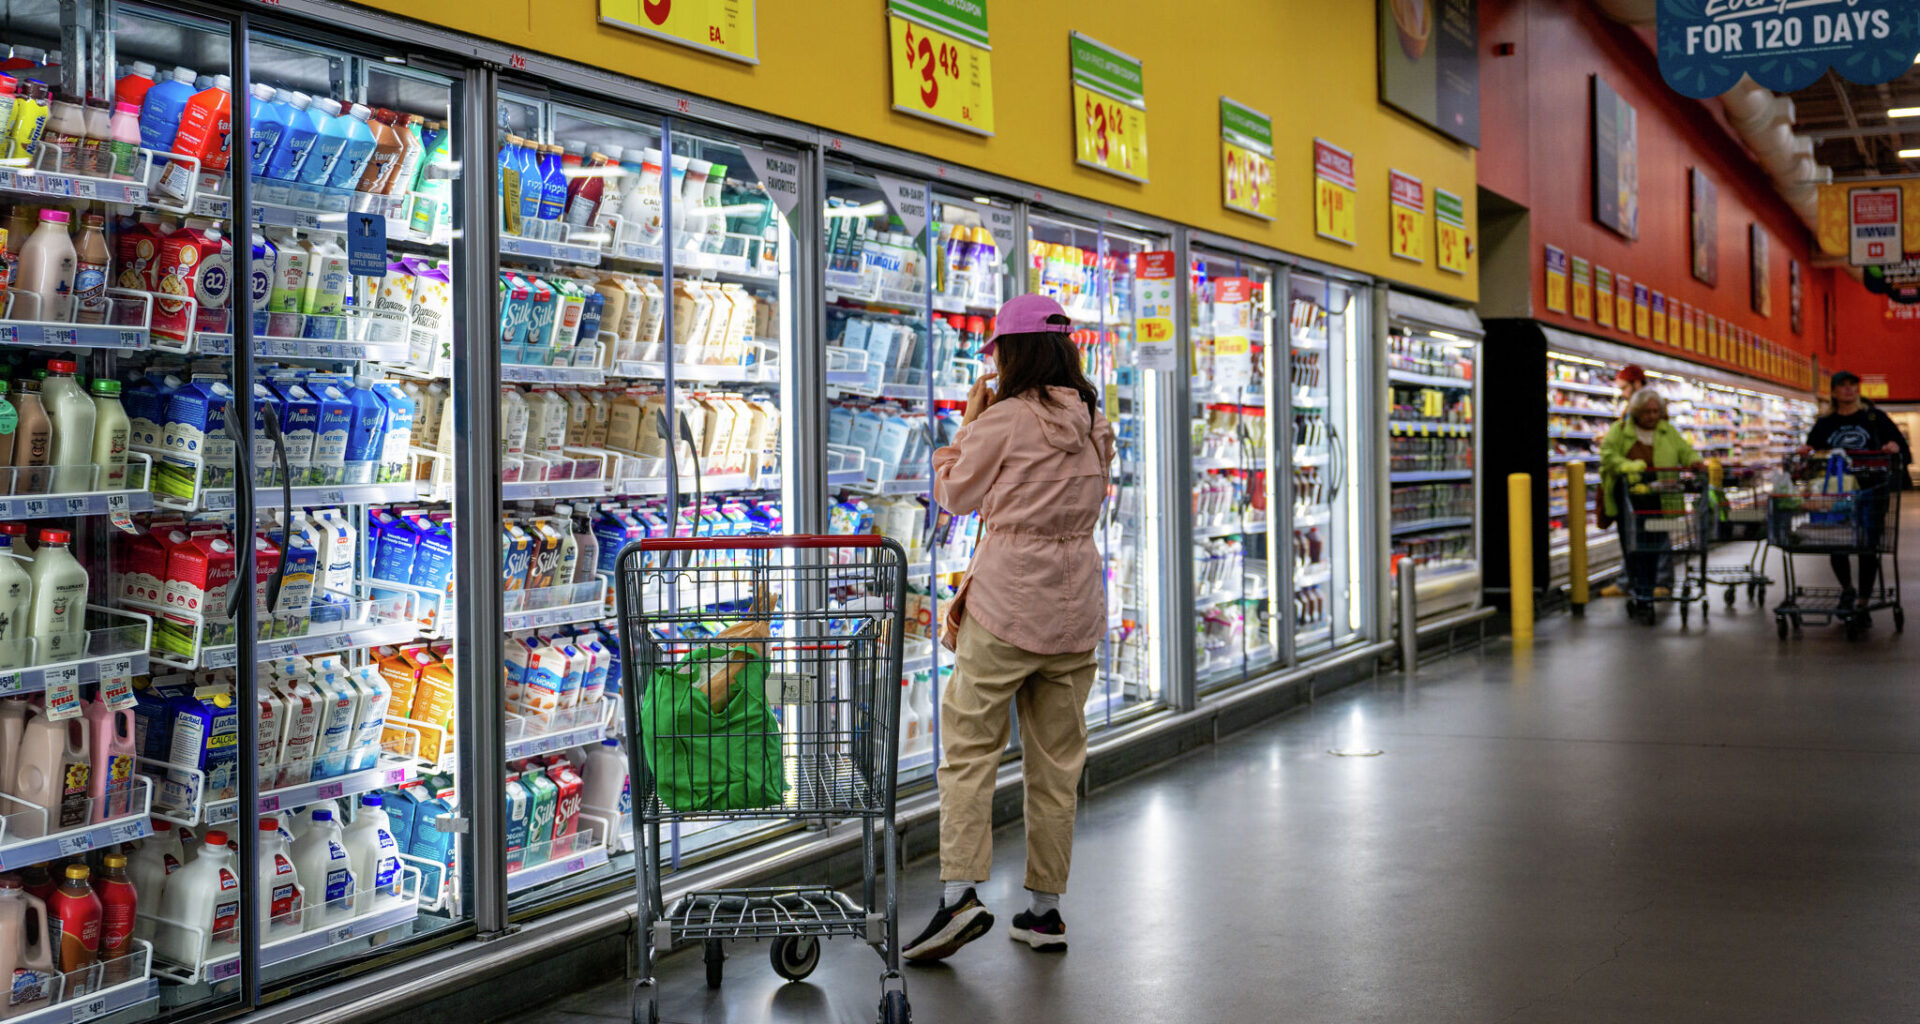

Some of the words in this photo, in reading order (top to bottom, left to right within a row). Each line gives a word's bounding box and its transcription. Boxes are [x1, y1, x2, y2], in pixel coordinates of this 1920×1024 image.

[709, 26, 724, 45] EA.
[1686, 26, 1743, 55] FOR
[1751, 17, 1802, 49] 120
[1813, 9, 1890, 45] DAYS
[766, 158, 797, 177] NON-DAIRY
[768, 176, 797, 194] FAVORITES
[206, 273, 224, 289] a2
[503, 303, 531, 328] Silk
[528, 306, 556, 331] Silk
[503, 550, 528, 579] Silk
[531, 548, 559, 578] Silk
[51, 694, 74, 708] TEXAS
[106, 686, 128, 700] TEXAS
[179, 713, 200, 725] Lactaid
[529, 803, 556, 833] Silk
[555, 793, 581, 825] Silk
